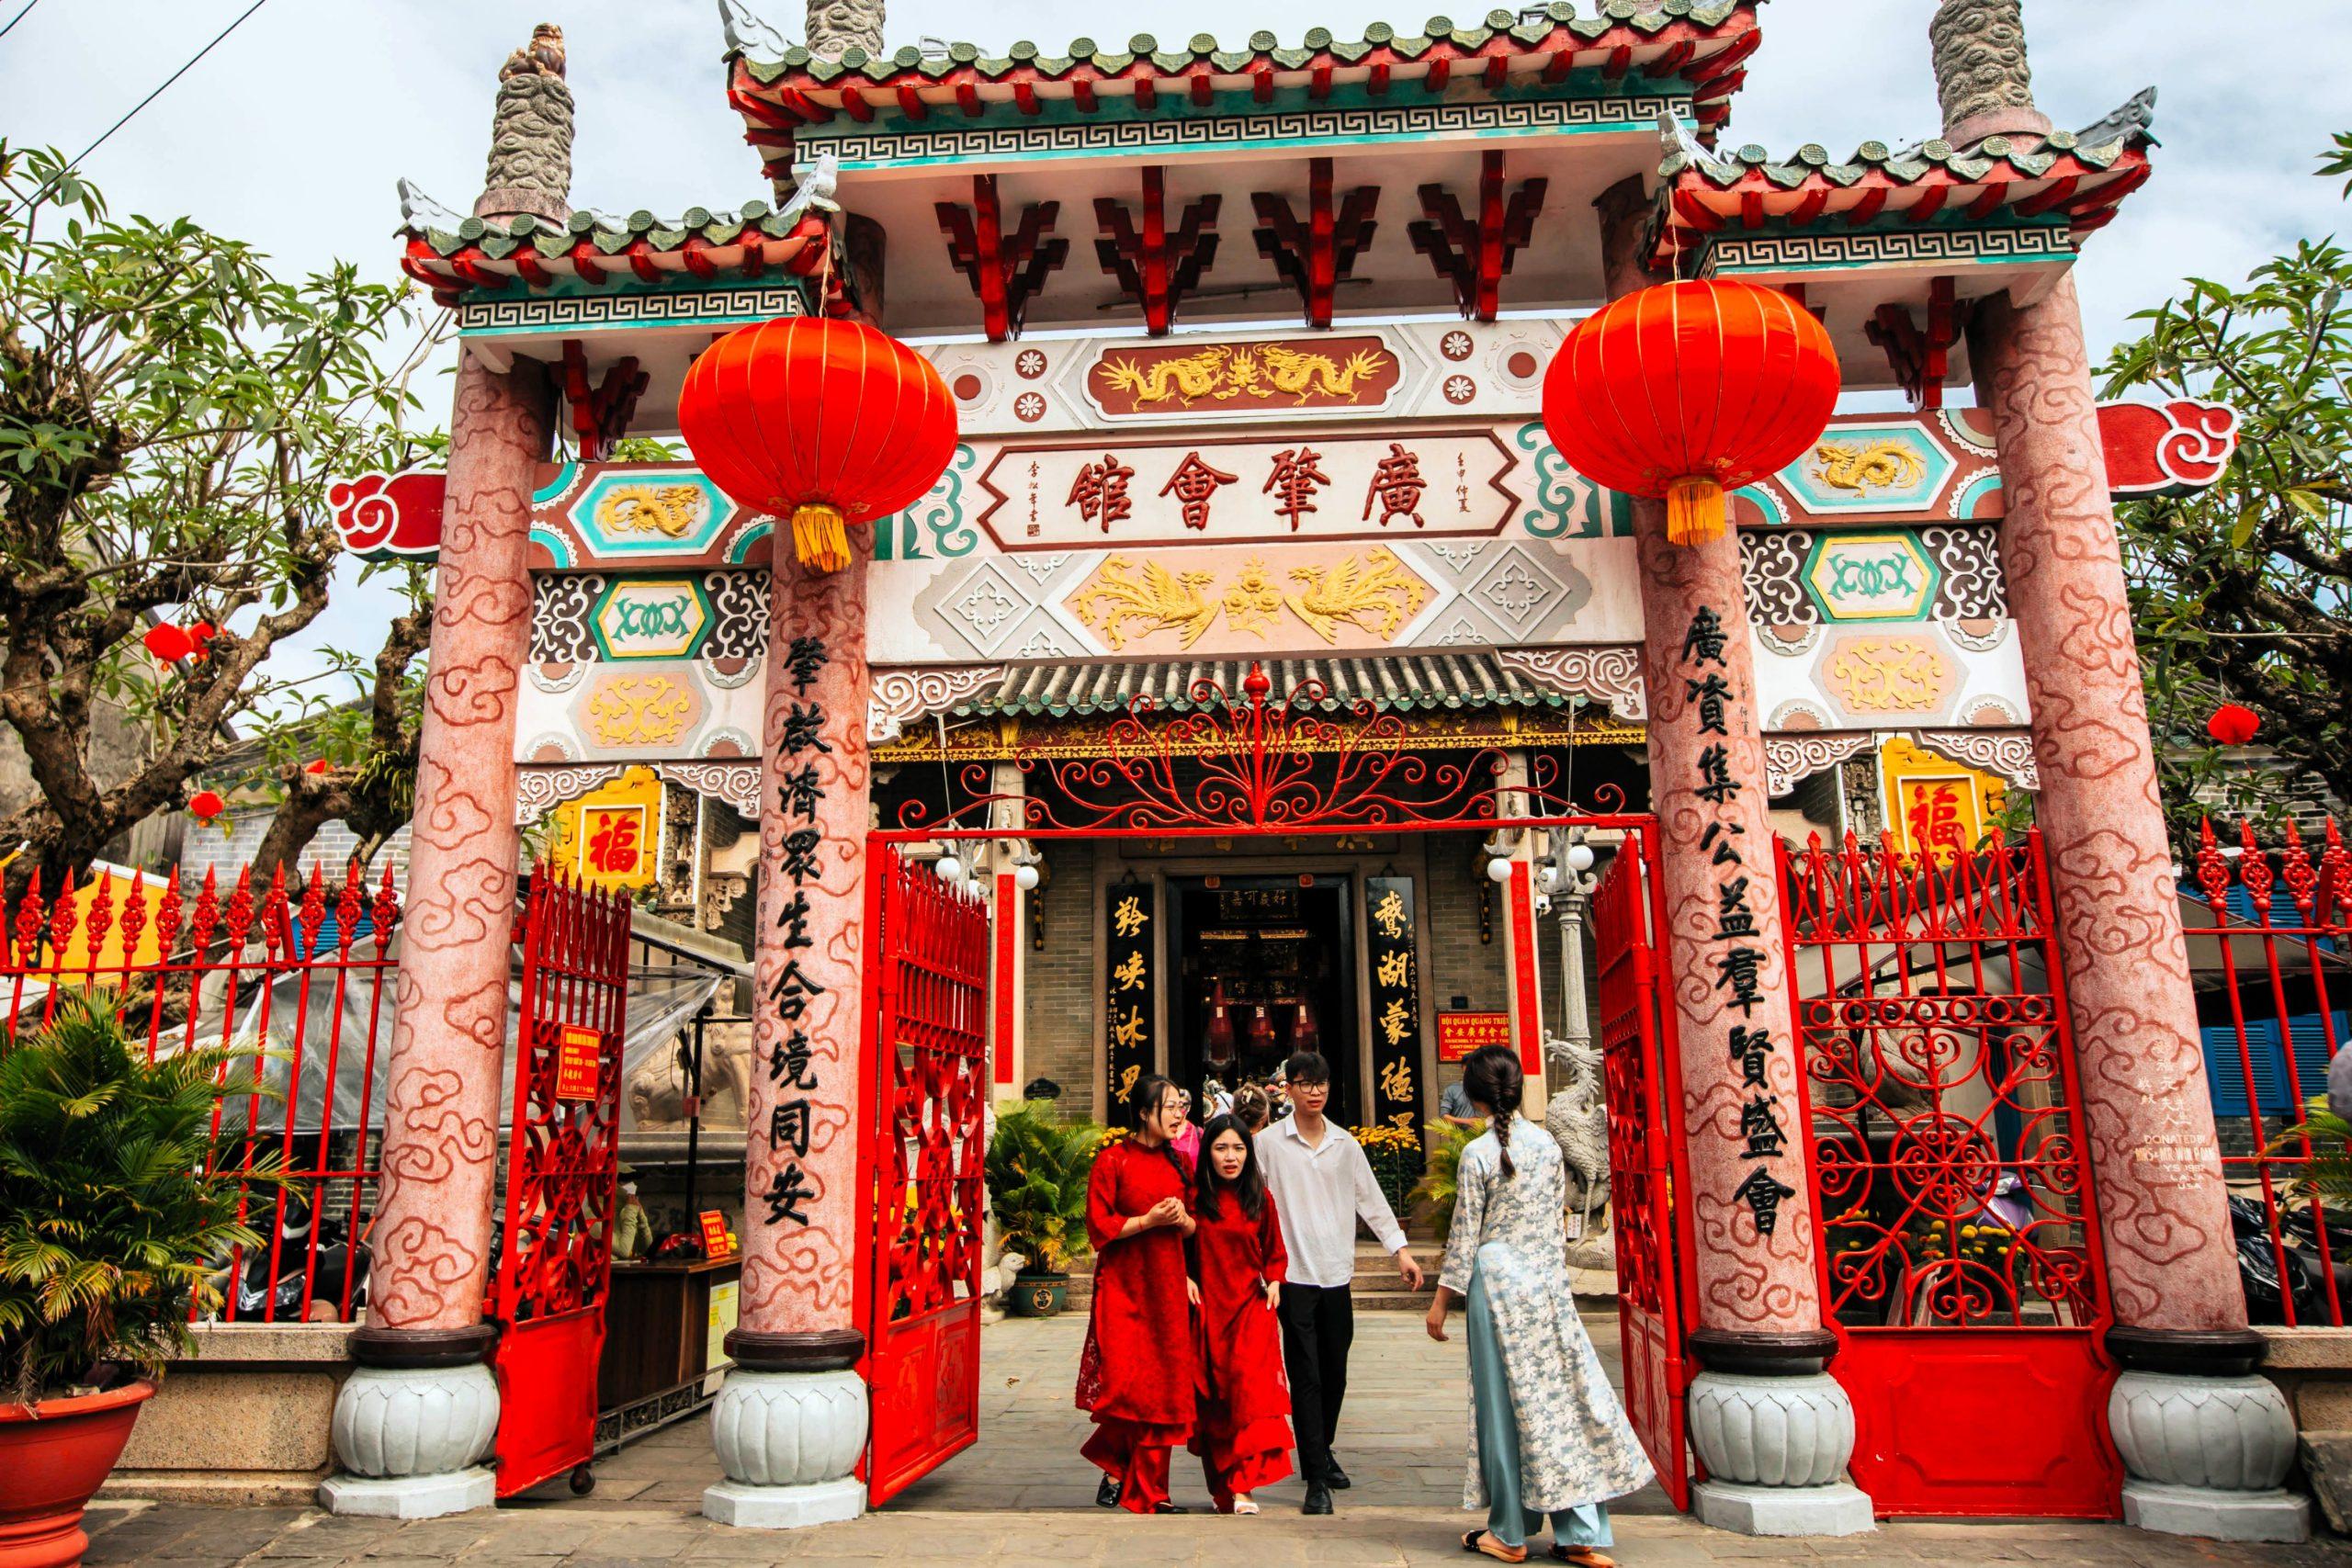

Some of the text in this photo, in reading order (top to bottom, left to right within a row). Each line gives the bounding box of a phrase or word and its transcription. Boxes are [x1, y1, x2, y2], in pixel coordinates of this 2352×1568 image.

[1065, 443, 1427, 534] 廣肇會館
[590, 813, 638, 873] 福
[1909, 784, 1964, 847] 福
[1442, 1017, 1452, 1026] HỘI
